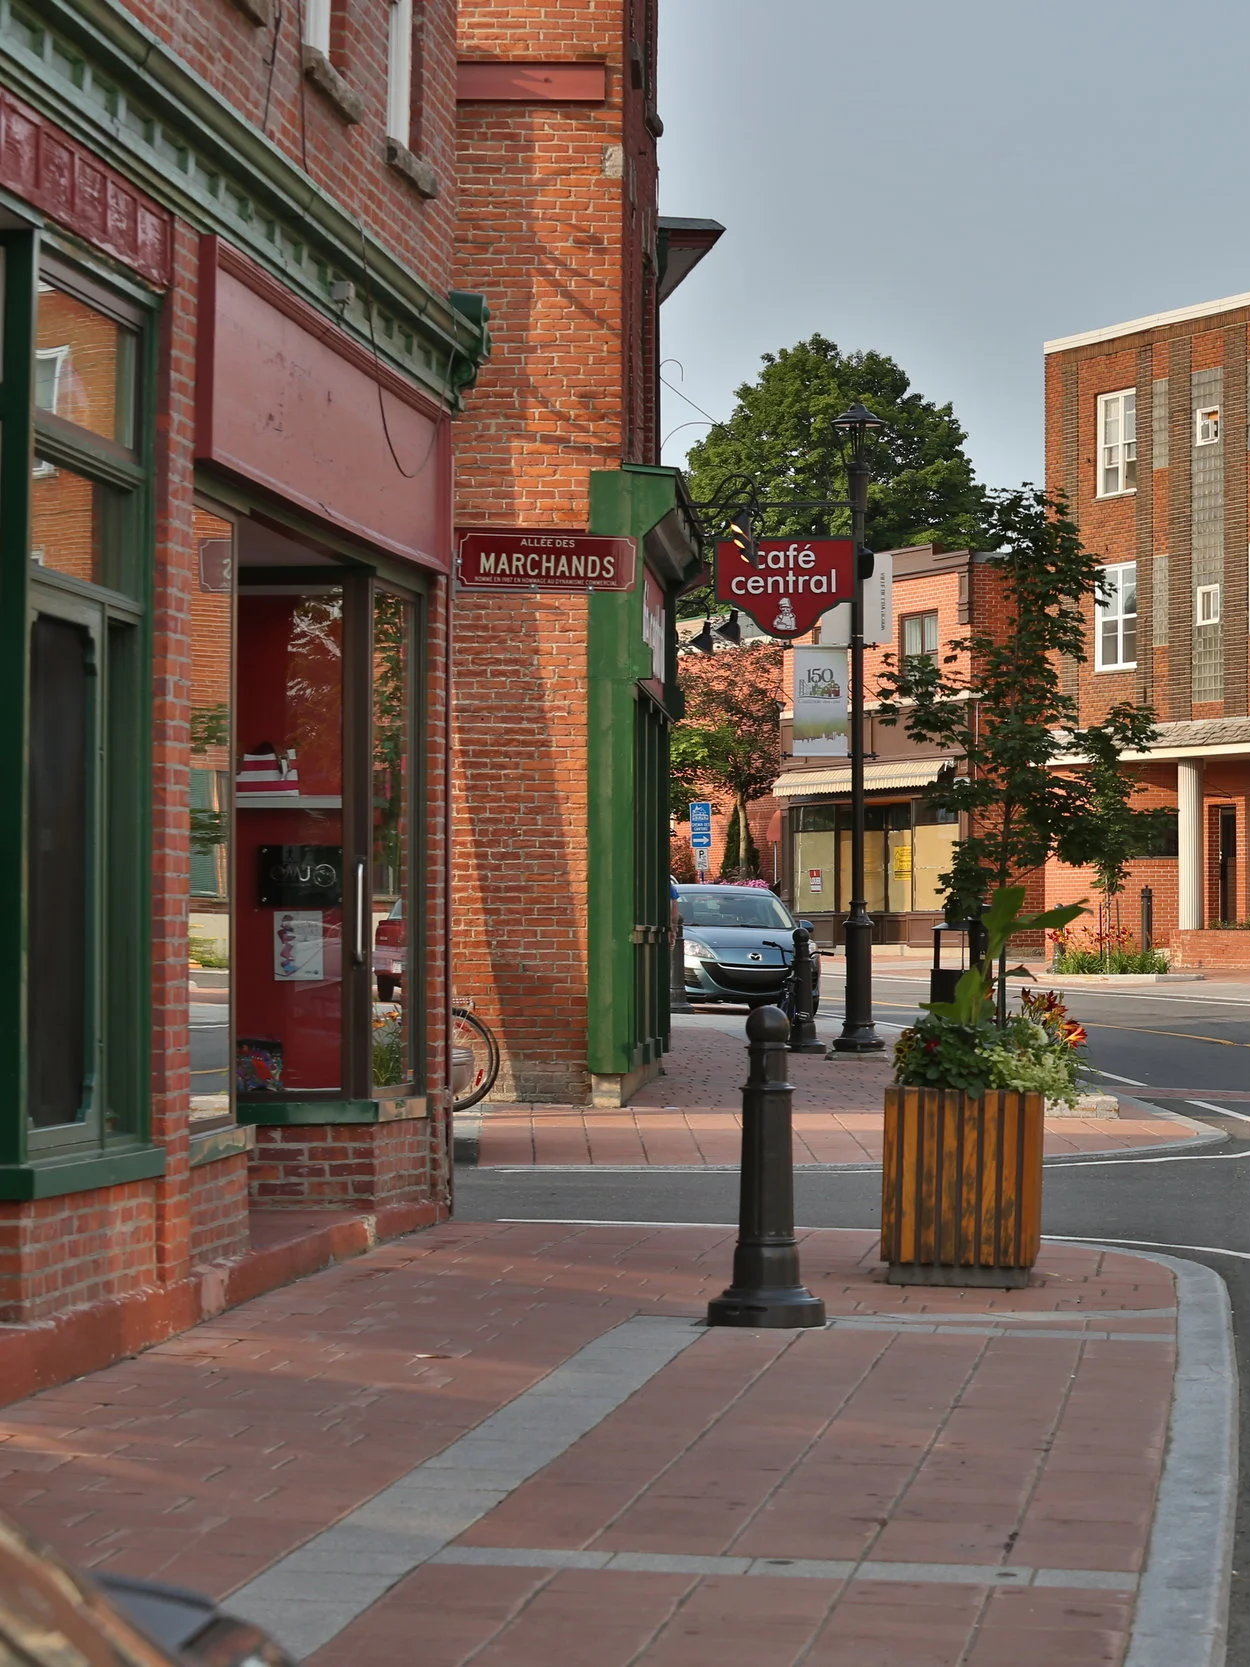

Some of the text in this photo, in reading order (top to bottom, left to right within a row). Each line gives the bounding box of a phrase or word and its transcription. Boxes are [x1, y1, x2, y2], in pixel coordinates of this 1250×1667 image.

[520, 536, 576, 548] ALLÉE DES
[479, 552, 615, 578] MARCHANDS
[522, 577, 547, 585] HOMMAGE
[585, 579, 618, 587] COMMERCIAL
[731, 568, 837, 595] central
[806, 668, 834, 683] 150
